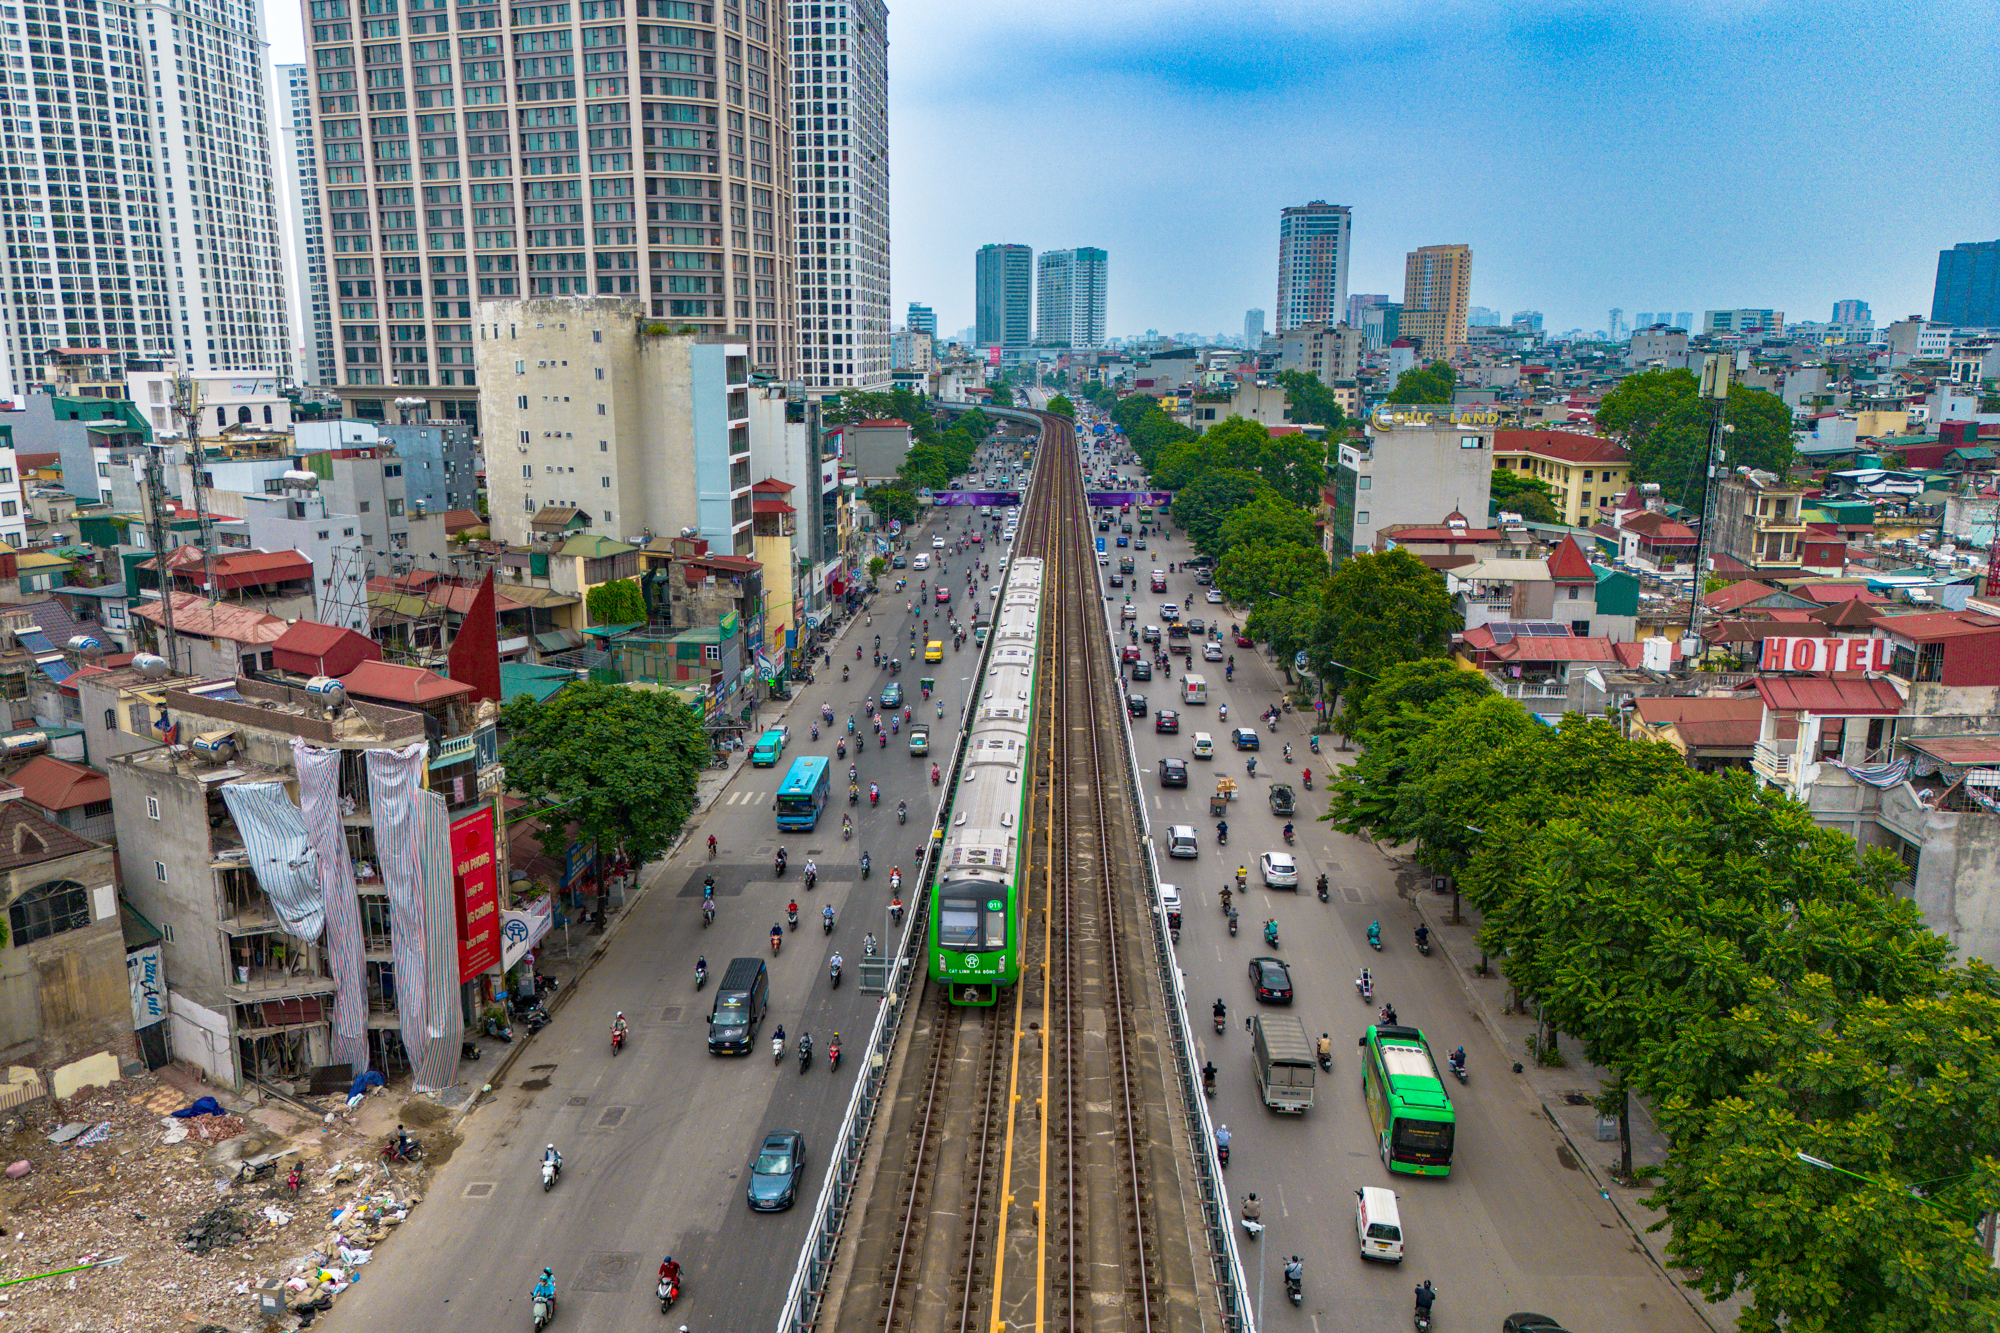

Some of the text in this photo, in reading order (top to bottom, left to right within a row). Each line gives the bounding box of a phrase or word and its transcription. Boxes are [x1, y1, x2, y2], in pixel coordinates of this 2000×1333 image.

[1393, 412, 1433, 423] CHIC
[1449, 412, 1499, 424] LAND
[1762, 638, 1891, 671] HOTEL
